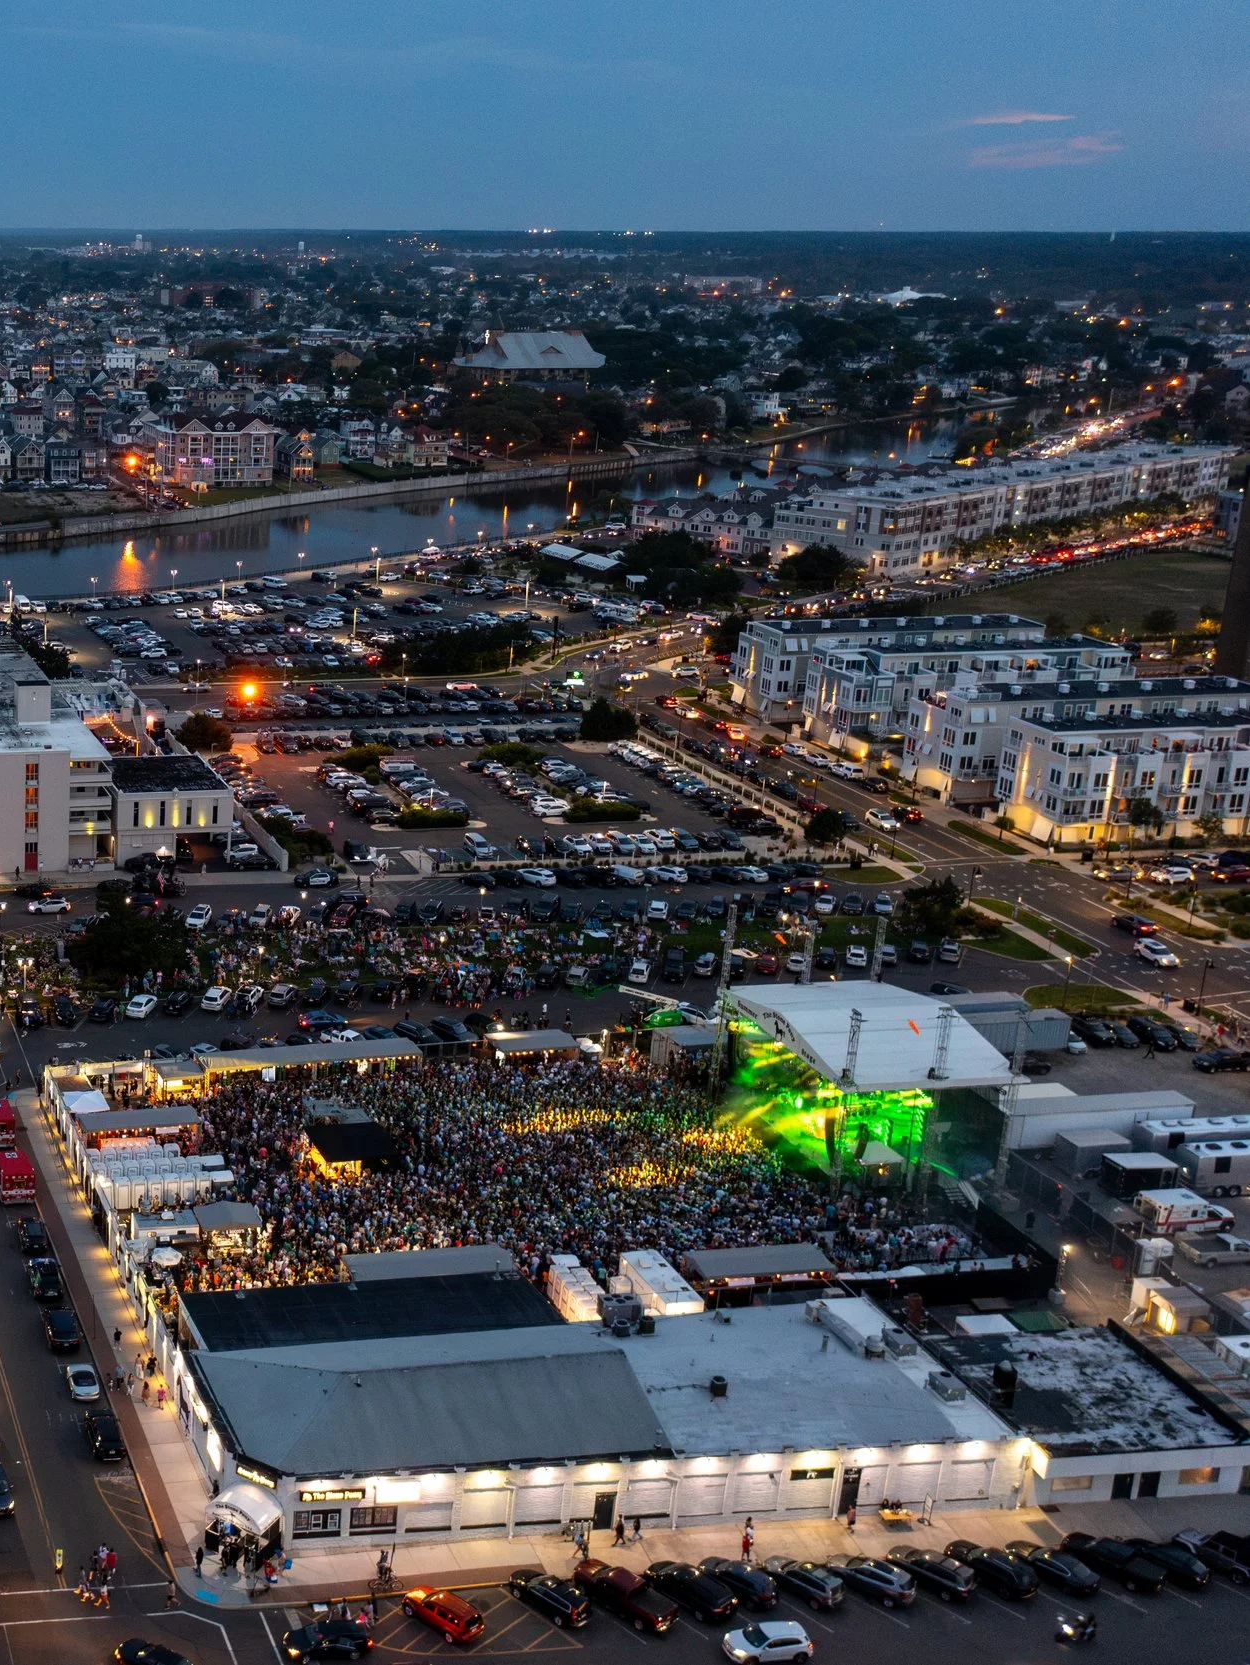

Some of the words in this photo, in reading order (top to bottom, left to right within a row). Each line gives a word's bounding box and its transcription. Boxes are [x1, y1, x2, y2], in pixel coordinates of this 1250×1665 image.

[737, 1000, 758, 1019] Summer
[762, 1012, 772, 1020] The
[772, 1011, 786, 1025] Stone
[785, 1022, 795, 1042] Pony
[801, 1048, 816, 1064] Stage
[313, 1491, 326, 1501] The
[224, 1504, 239, 1513] Stone
